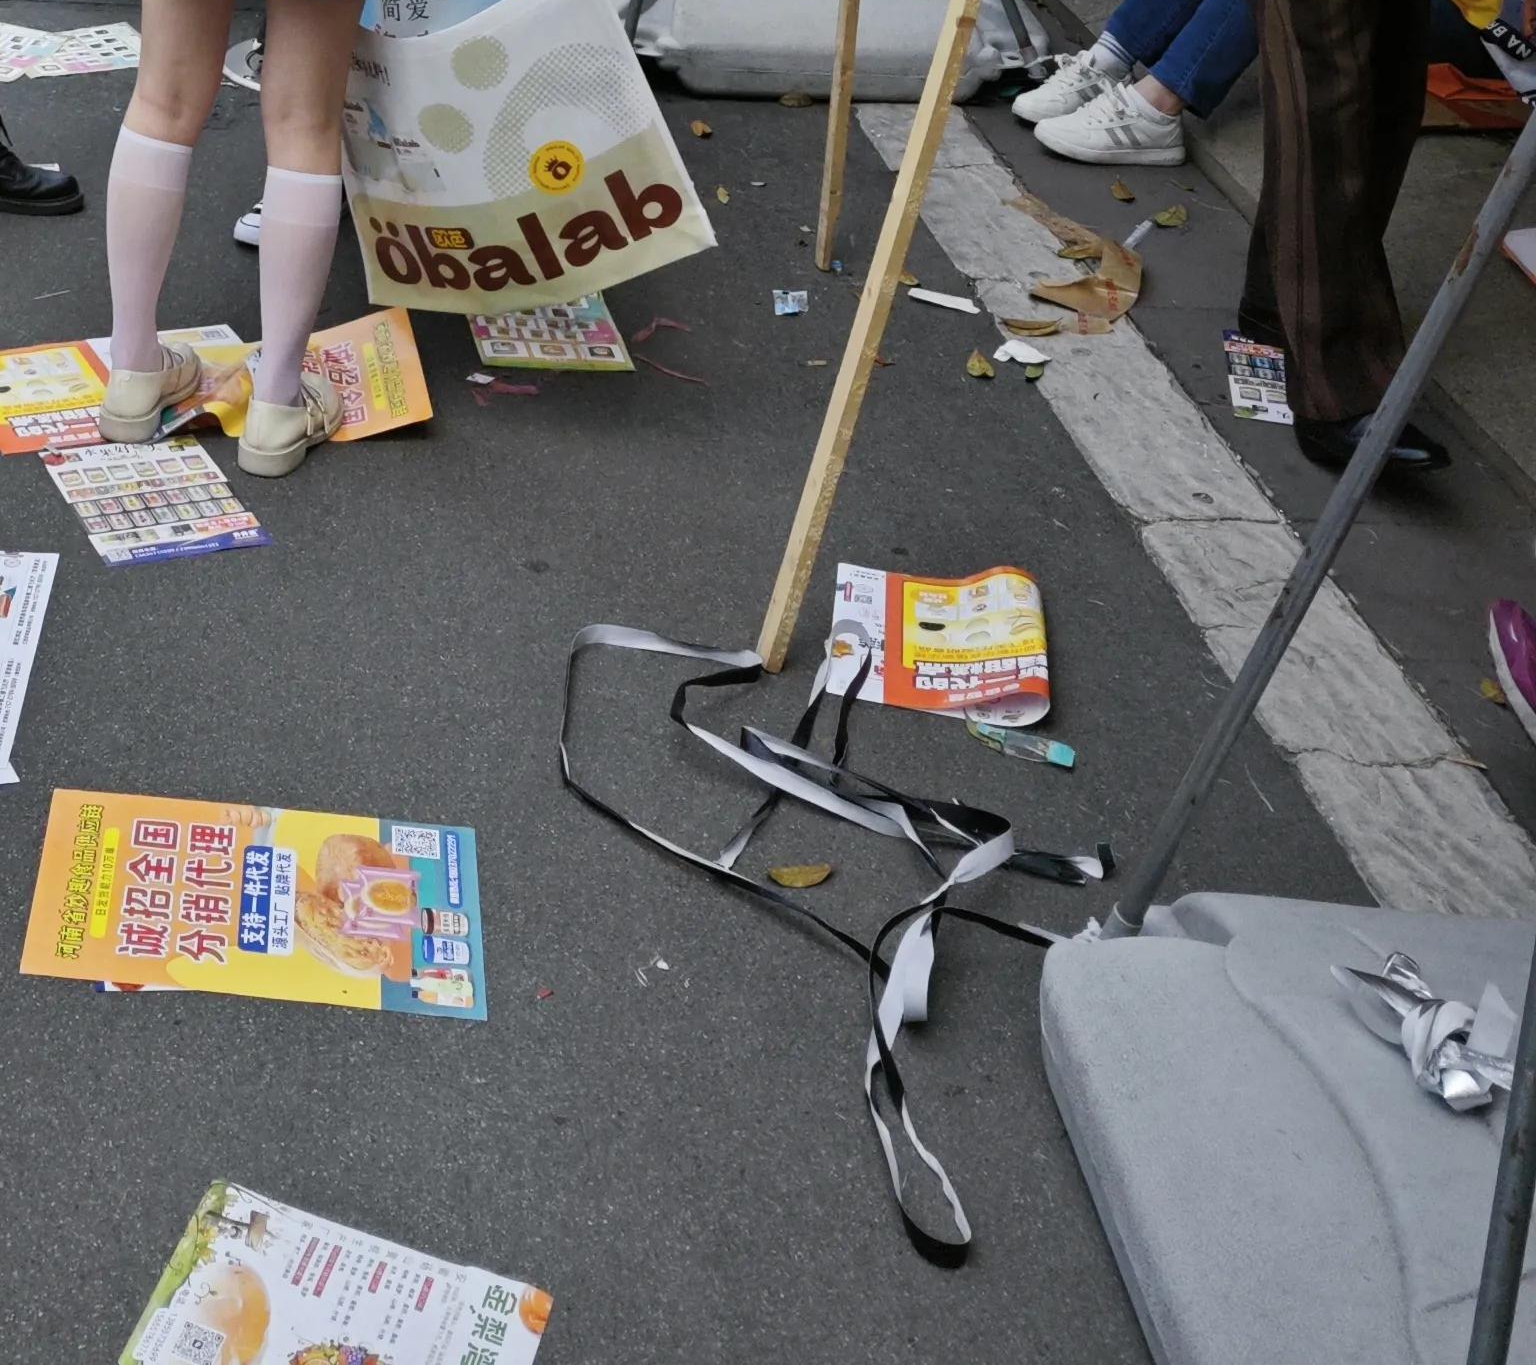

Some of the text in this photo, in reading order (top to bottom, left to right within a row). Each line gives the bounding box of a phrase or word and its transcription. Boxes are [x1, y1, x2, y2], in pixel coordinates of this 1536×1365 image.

[54, 803, 106, 960] 河南省妙趣食品供应链
[115, 818, 183, 959] 诚招全国
[175, 822, 237, 966] 分销代理
[239, 849, 273, 946] 支持一件代发
